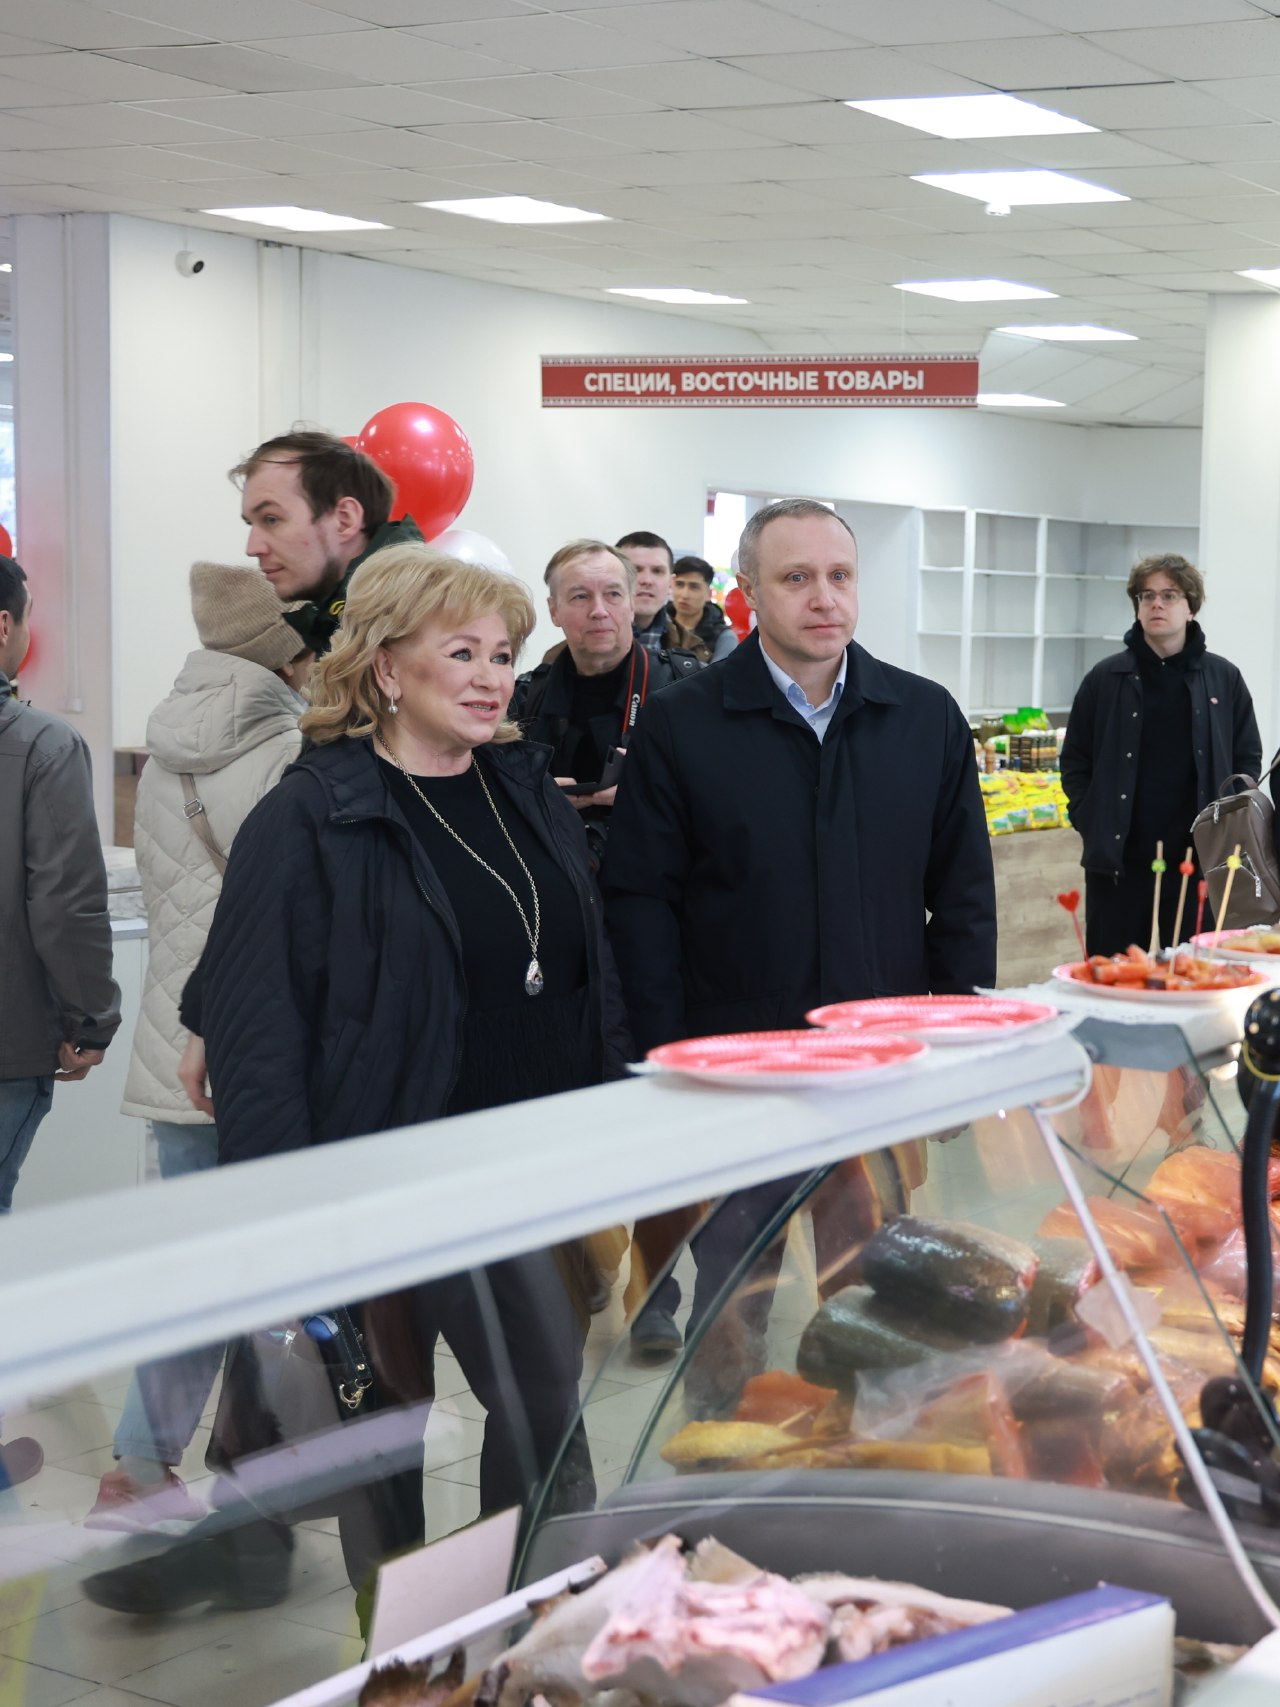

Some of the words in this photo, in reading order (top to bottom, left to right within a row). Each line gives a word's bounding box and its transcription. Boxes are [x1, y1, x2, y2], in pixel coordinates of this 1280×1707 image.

[584, 371, 676, 394] СПЕЦИИ,
[681, 370, 818, 392] ВОСТОЧНЫЕ
[825, 370, 924, 391] ТОВАРЫ
[629, 693, 640, 726] Canon
